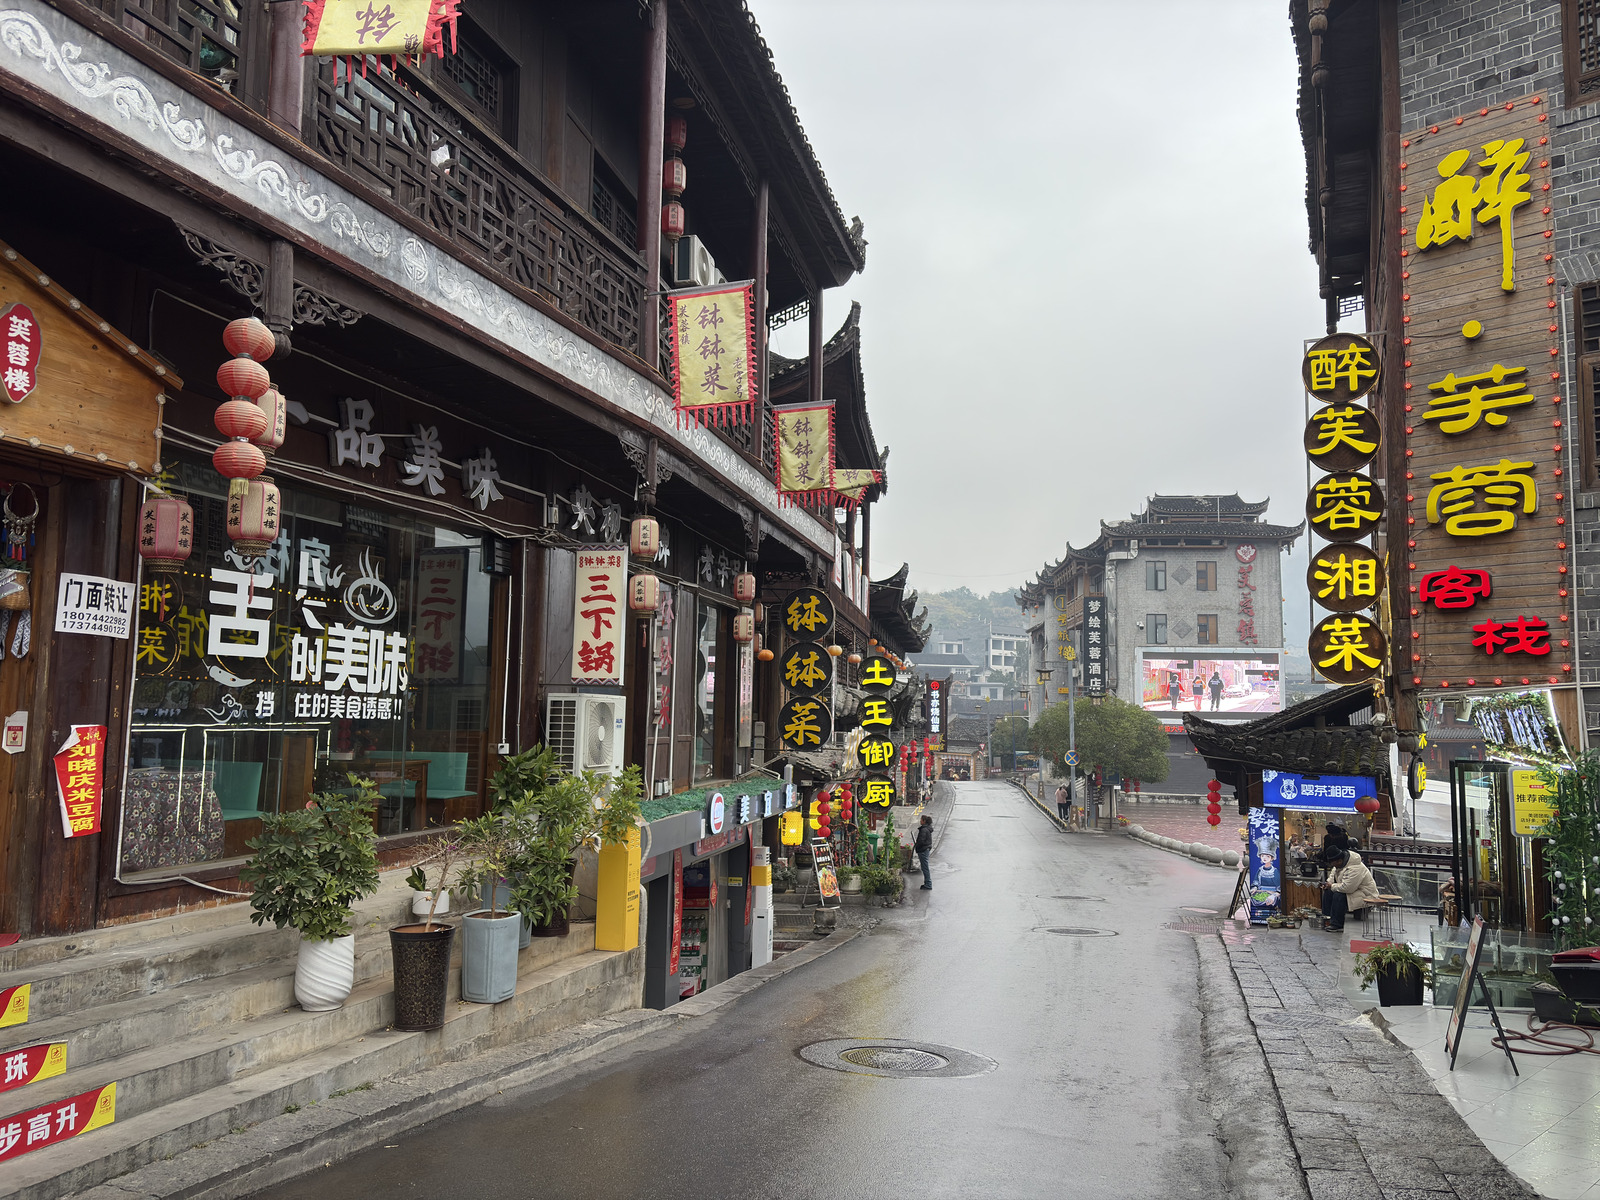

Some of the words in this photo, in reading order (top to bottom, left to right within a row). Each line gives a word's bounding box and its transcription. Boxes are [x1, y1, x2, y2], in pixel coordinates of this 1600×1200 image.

[4, 315, 32, 394] 芙蓉楼
[694, 303, 728, 396] 钵钵菜
[791, 417, 815, 485] 钵钵菜
[1308, 343, 1381, 671] 醉芙蓉湘菜
[62, 621, 126, 635] 17374490122
[63, 611, 127, 626] 18074422982
[64, 578, 128, 613] 门面转让
[577, 574, 617, 674] 三下锅
[784, 595, 828, 745] 钵钵菜
[860, 660, 894, 807] 土王御厨
[66, 743, 97, 832] 刘晓庆米豆腐
[1301, 784, 1356, 798] 翠茶湘西
[5, 1052, 28, 1083] 珠
